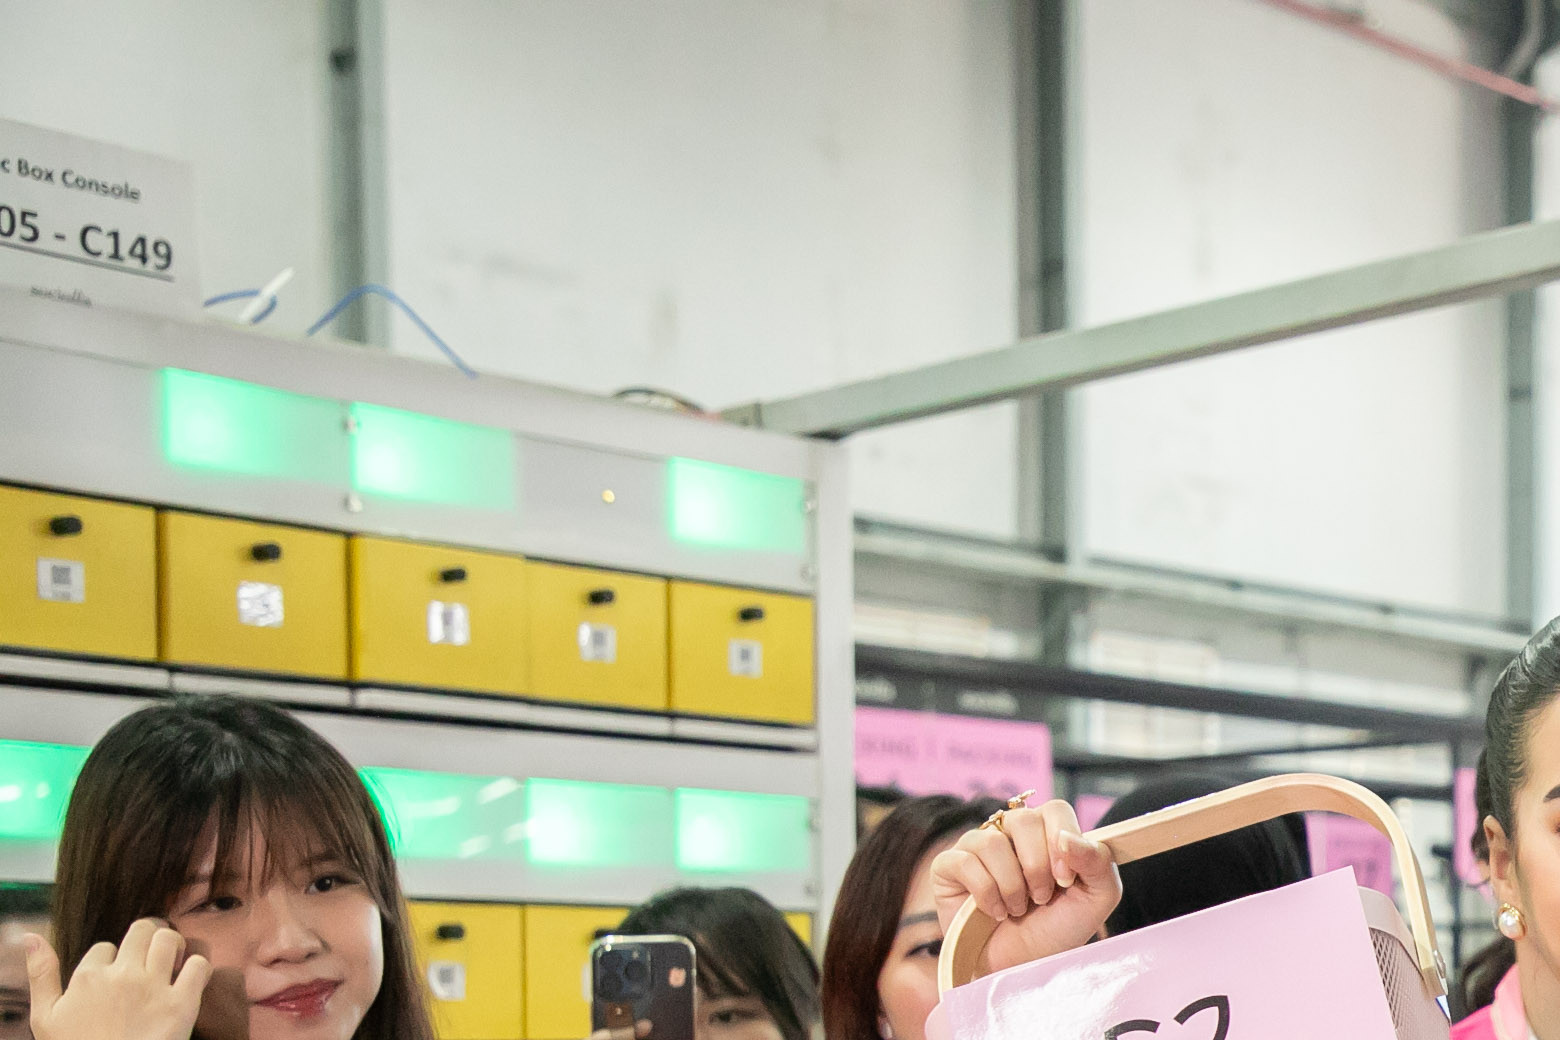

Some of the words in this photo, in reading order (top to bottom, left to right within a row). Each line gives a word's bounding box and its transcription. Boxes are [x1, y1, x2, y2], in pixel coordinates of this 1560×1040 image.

[17, 158, 55, 183] Box
[61, 169, 142, 202] Console
[79, 223, 174, 272] C149
